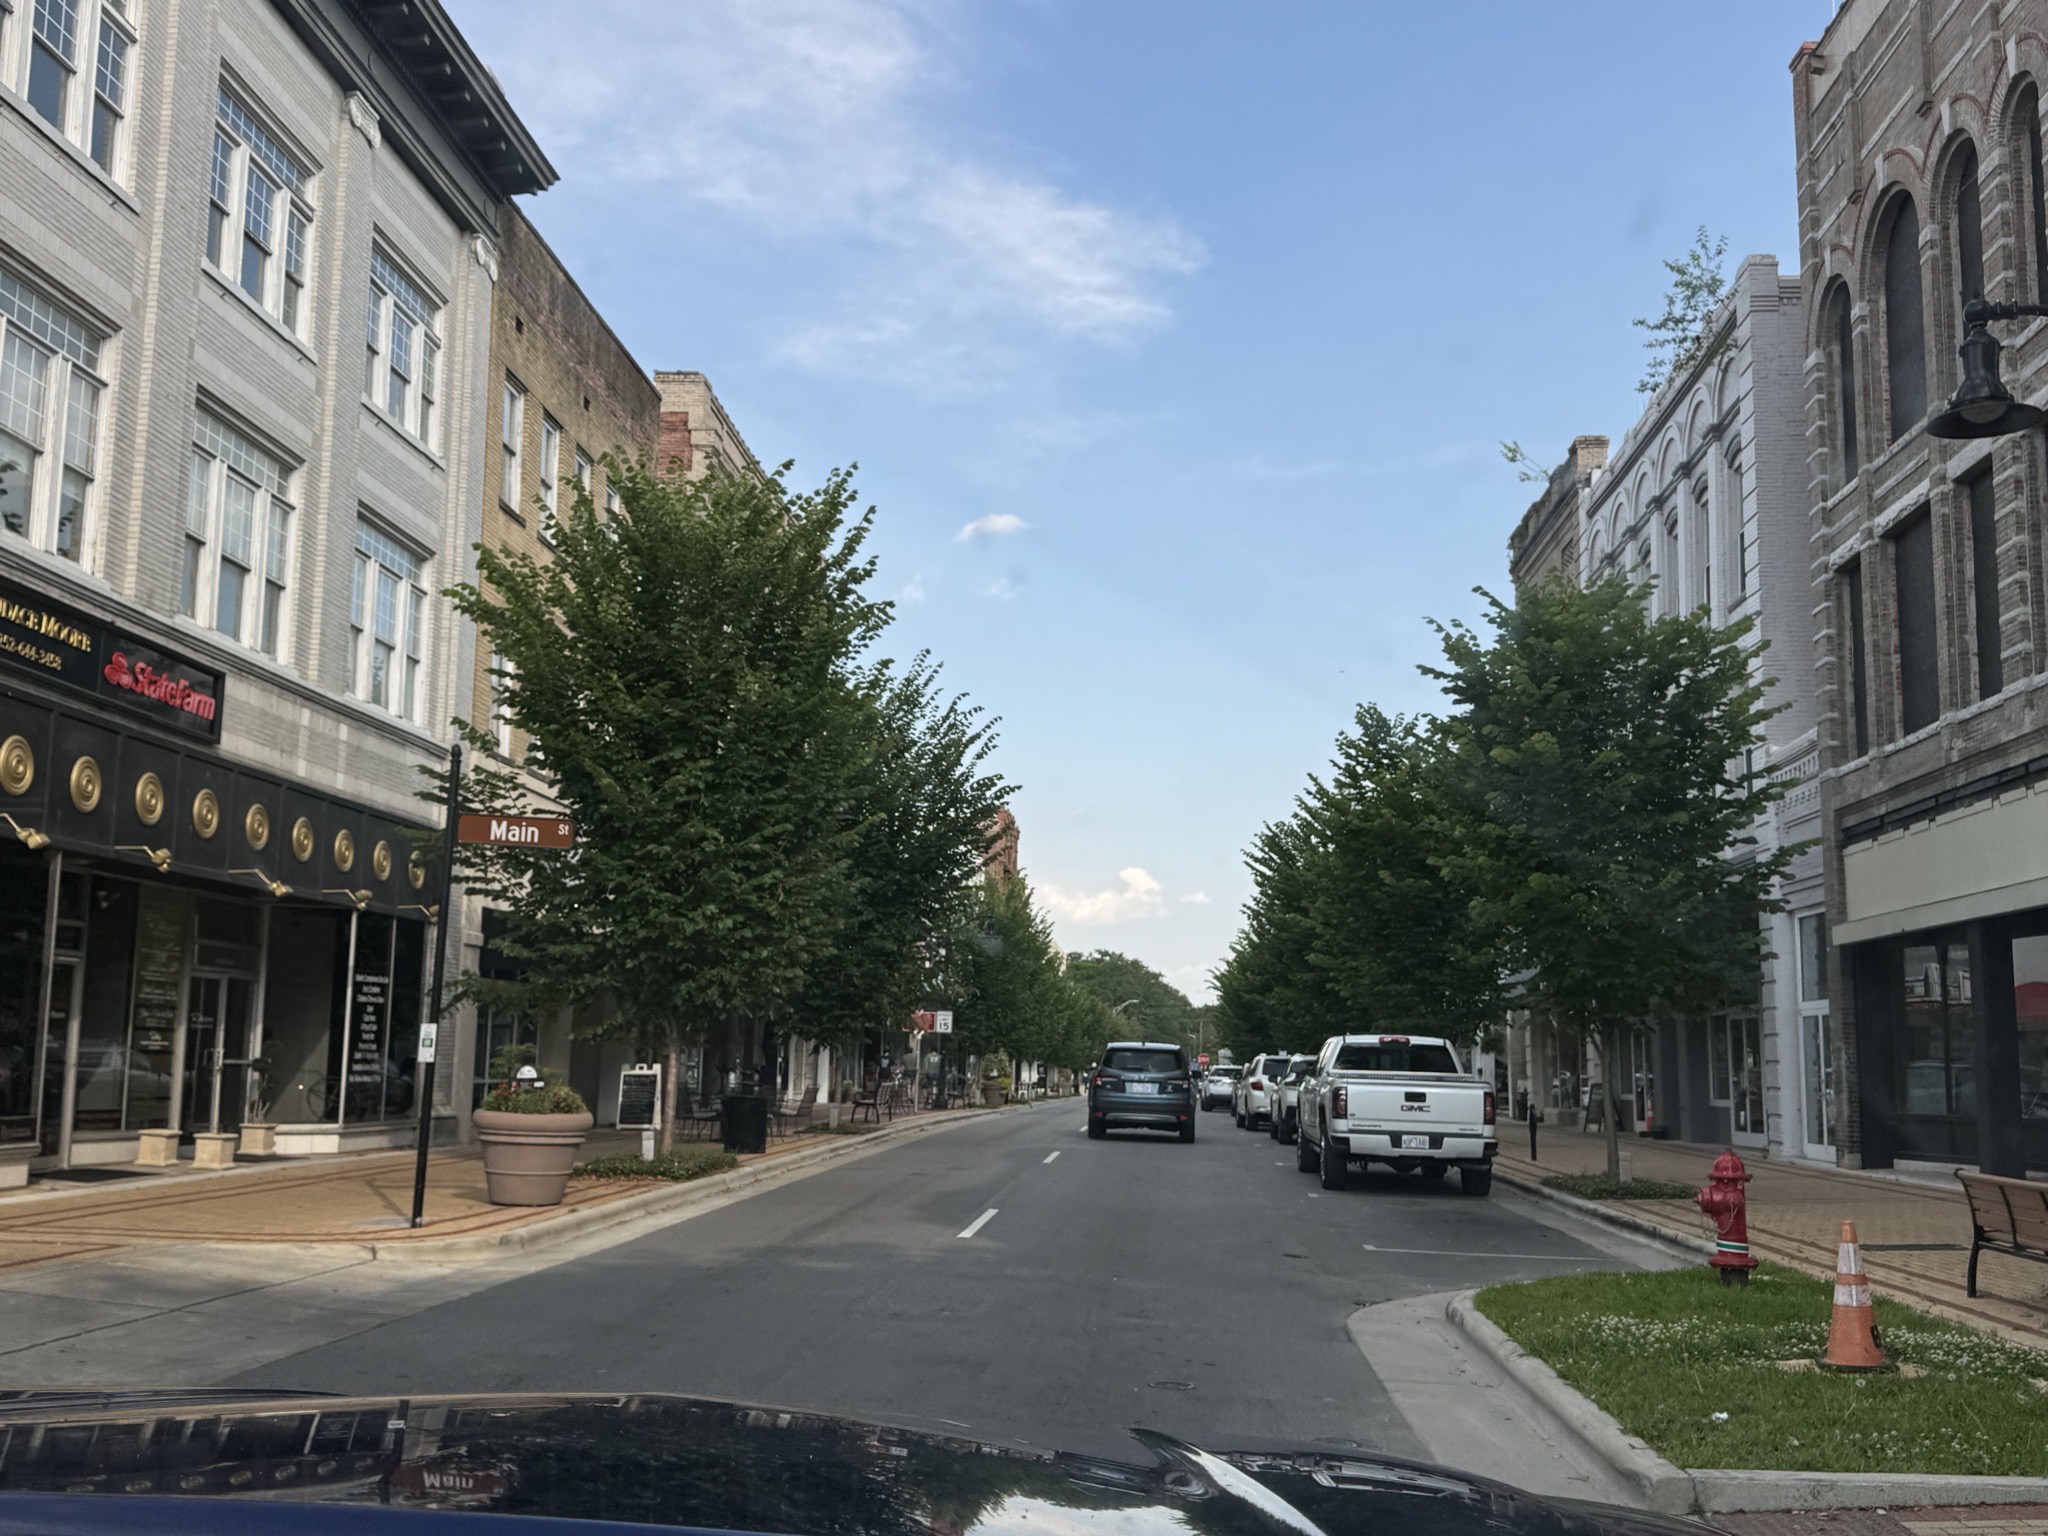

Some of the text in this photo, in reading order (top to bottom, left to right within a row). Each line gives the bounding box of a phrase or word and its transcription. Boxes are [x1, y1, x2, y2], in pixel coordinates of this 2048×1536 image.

[490, 819, 570, 843] Main St
[939, 1022, 950, 1030] 15
[1400, 1104, 1431, 1113] GMC
